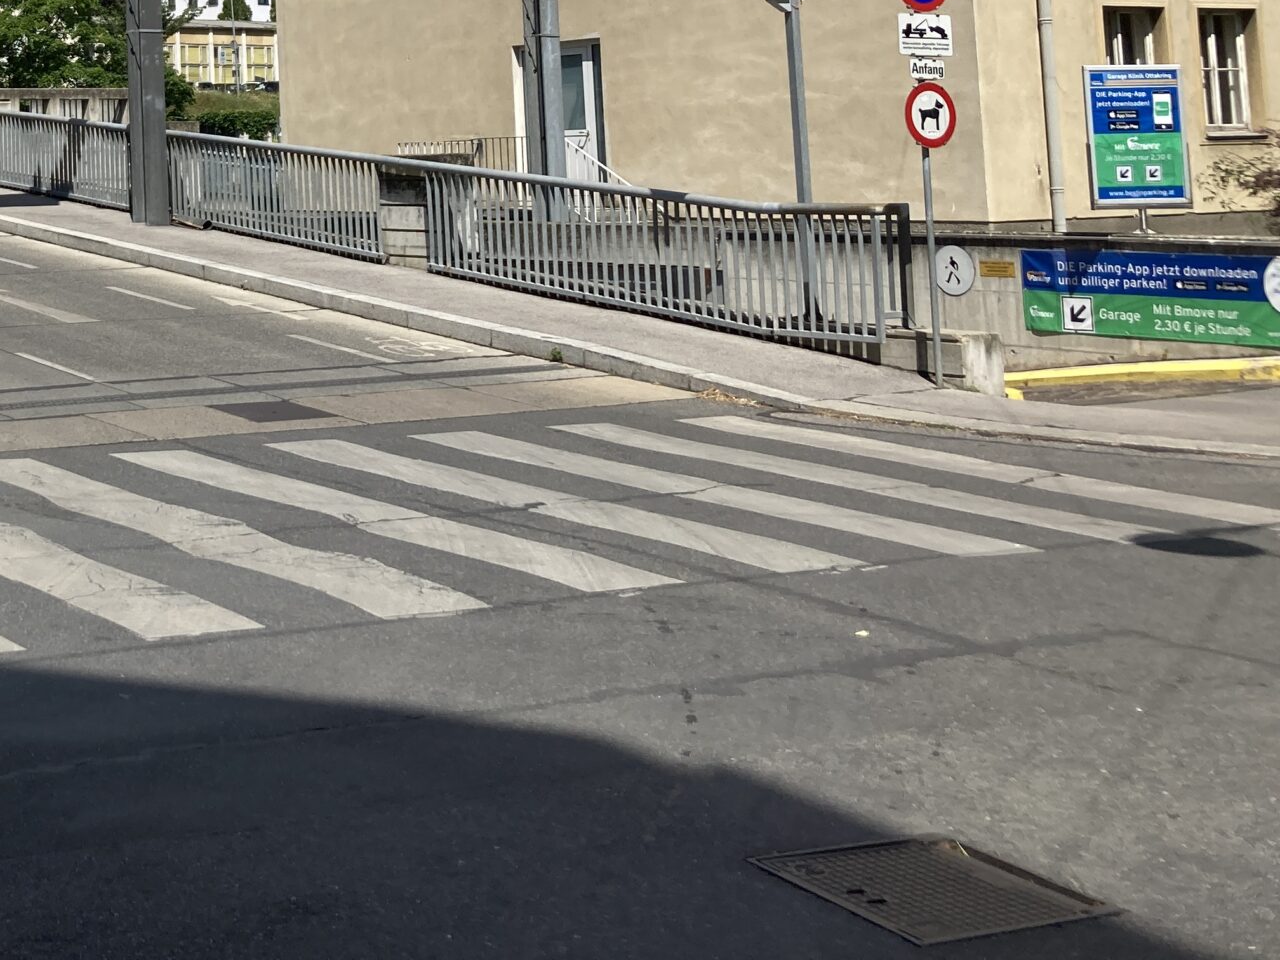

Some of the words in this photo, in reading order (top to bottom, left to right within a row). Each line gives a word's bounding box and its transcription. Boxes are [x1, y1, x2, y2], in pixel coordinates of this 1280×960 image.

[911, 62, 944, 78] Anfang
[1108, 91, 1147, 99] Parking-App
[1057, 261, 1076, 272] DIE
[1079, 262, 1150, 277] Parking-App
[1152, 263, 1181, 276] jetzt
[1183, 265, 1258, 280] downloaden
[1058, 275, 1078, 286] und
[1081, 276, 1120, 289] billiger
[1124, 278, 1168, 290] parken!
[1099, 308, 1141, 323] Garage
[1153, 303, 1172, 316] Mit
[1174, 305, 1215, 318] Bmove
[1218, 309, 1240, 320] nur
[1183, 321, 1192, 333] €
[1194, 323, 1205, 336] je
[1208, 322, 1252, 337] Stunde
